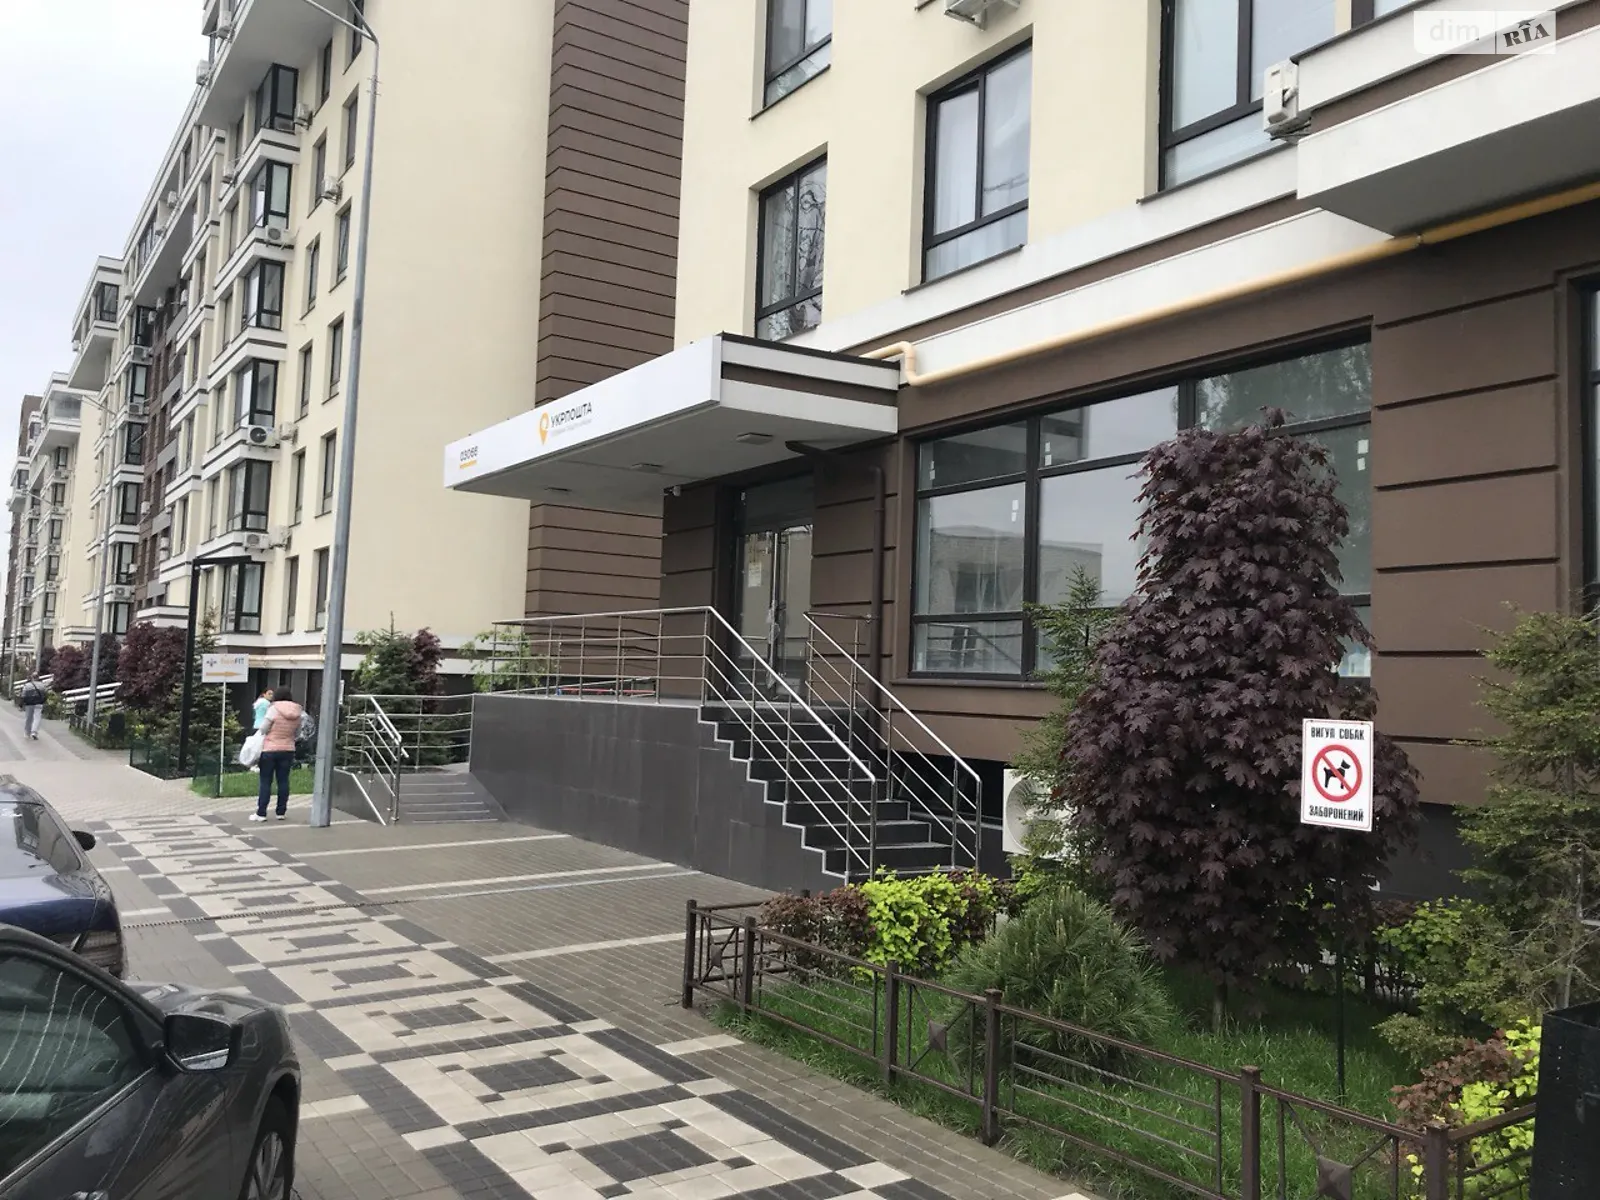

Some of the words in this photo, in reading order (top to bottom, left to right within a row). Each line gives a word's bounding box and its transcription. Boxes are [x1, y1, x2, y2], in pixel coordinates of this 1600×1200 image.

[550, 402, 592, 428] УКРПОШТА
[1311, 727, 1335, 738] ВИГУЛ
[1339, 728, 1364, 740] СОБАК
[1309, 805, 1364, 822] ЗАБОРОНЕНИЙ
